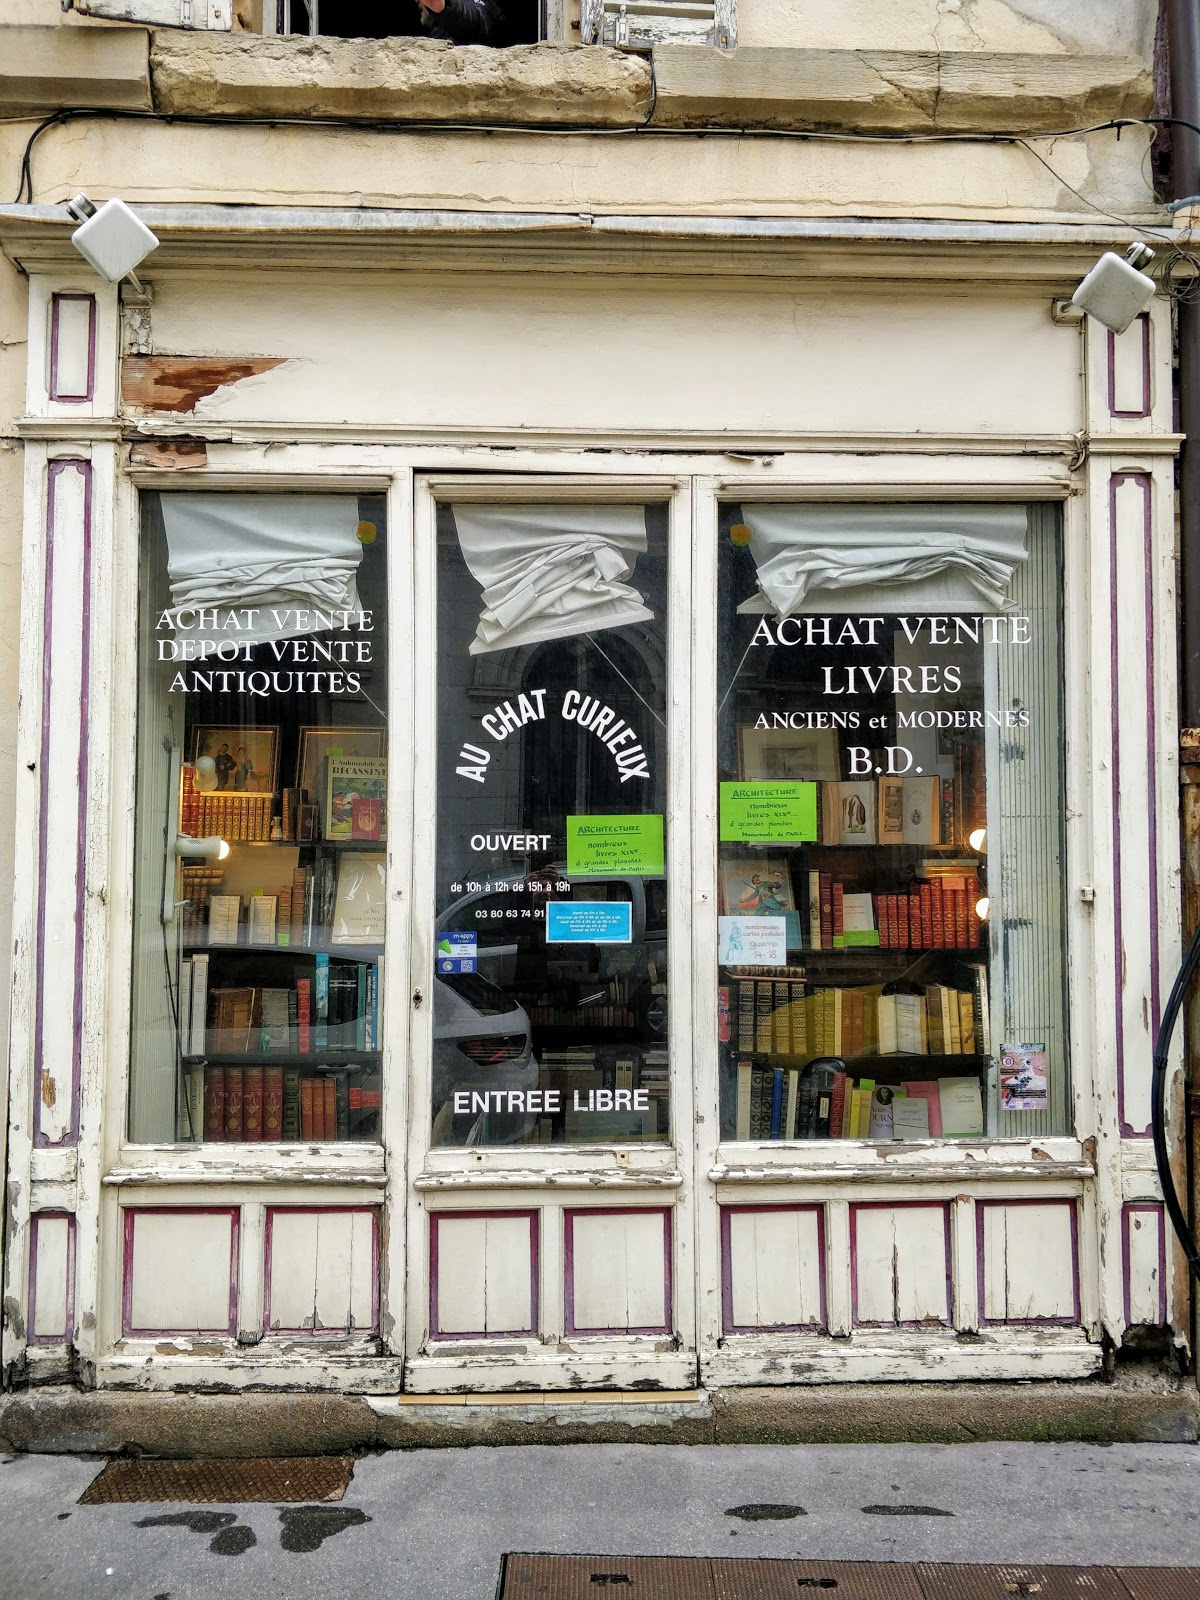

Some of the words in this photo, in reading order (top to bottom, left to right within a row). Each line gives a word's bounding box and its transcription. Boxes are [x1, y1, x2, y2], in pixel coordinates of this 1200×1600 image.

[155, 608, 260, 630] ACHAT
[270, 610, 374, 632] VENTE
[750, 616, 884, 646] ACHAT
[897, 617, 1032, 645] VENTE
[156, 640, 259, 662] DEPOT
[267, 640, 372, 662] VENTE
[168, 671, 361, 696] ANTIQUITES
[822, 666, 962, 694] LIVRES
[754, 711, 860, 730] ANCIENS
[868, 713, 888, 729] et
[896, 710, 1030, 728] MODERNES
[456, 742, 491, 784] AU
[482, 688, 547, 741] CHAT
[562, 690, 650, 784] CURIEUX
[846, 746, 924, 774] B.D.
[732, 788, 798, 798] ARCHITECTURE
[578, 825, 641, 834] ARCHITECTURE
[738, 821, 764, 830] grandes
[470, 834, 552, 851] OUVERT
[588, 840, 628, 849] nombreux
[584, 859, 608, 868] grandes
[450, 882, 462, 892] de
[466, 882, 482, 892] 10h
[485, 882, 492, 892] à
[494, 882, 509, 892] 12h
[513, 882, 524, 892] de
[527, 882, 543, 892] 15h
[546, 882, 552, 892] à
[555, 881, 571, 892] 19h
[476, 910, 488, 918] 03
[490, 910, 502, 918] 80
[506, 910, 518, 918] 63
[520, 910, 531, 918] 74
[534, 910, 545, 918] 91
[749, 941, 777, 950] guerre
[454, 1090, 560, 1114] ENTREE
[574, 1088, 650, 1112] LIBRE
